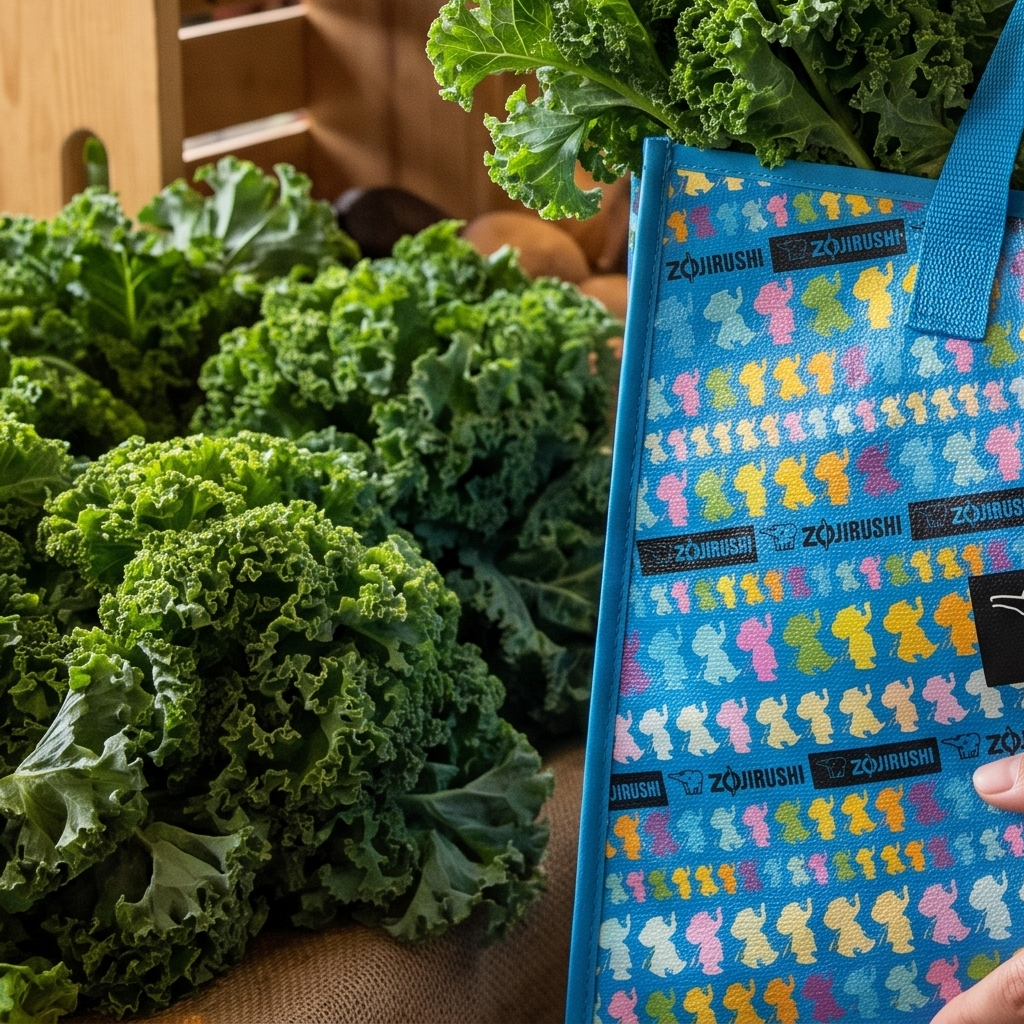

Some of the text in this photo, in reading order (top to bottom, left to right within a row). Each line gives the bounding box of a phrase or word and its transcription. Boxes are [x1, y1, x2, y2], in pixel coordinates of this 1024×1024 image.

[666, 228, 902, 283] ZOJIRUSHI ZOJIRUSHI
[674, 535, 753, 564] ZOJIRUSHI
[802, 515, 903, 551] ZOJIRUSHI
[708, 765, 805, 797] ZOJIRUSHI
[850, 747, 935, 778] ZOJIRUSHI
